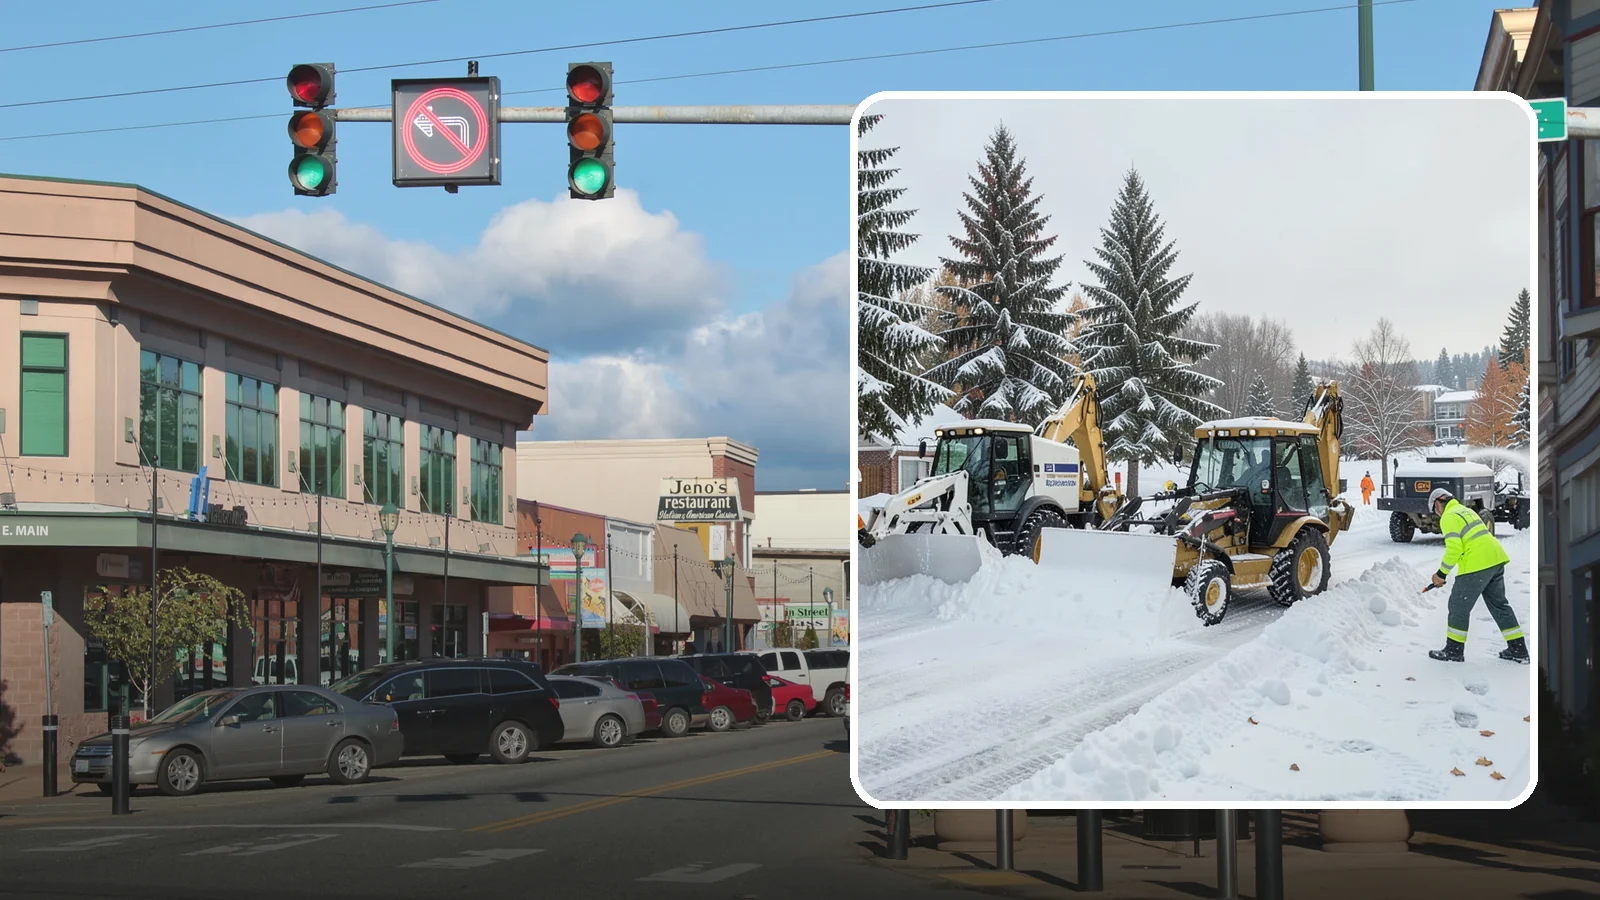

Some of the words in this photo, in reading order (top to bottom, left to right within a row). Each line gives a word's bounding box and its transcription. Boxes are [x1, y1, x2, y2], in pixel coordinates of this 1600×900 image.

[669, 480, 728, 495] Jeno's
[665, 496, 731, 509] restaurant
[685, 510, 714, 519] American
[715, 510, 738, 519] Cuisine
[2, 525, 13, 536] E.
[15, 525, 49, 536] MAIN
[797, 607, 828, 618] Street
